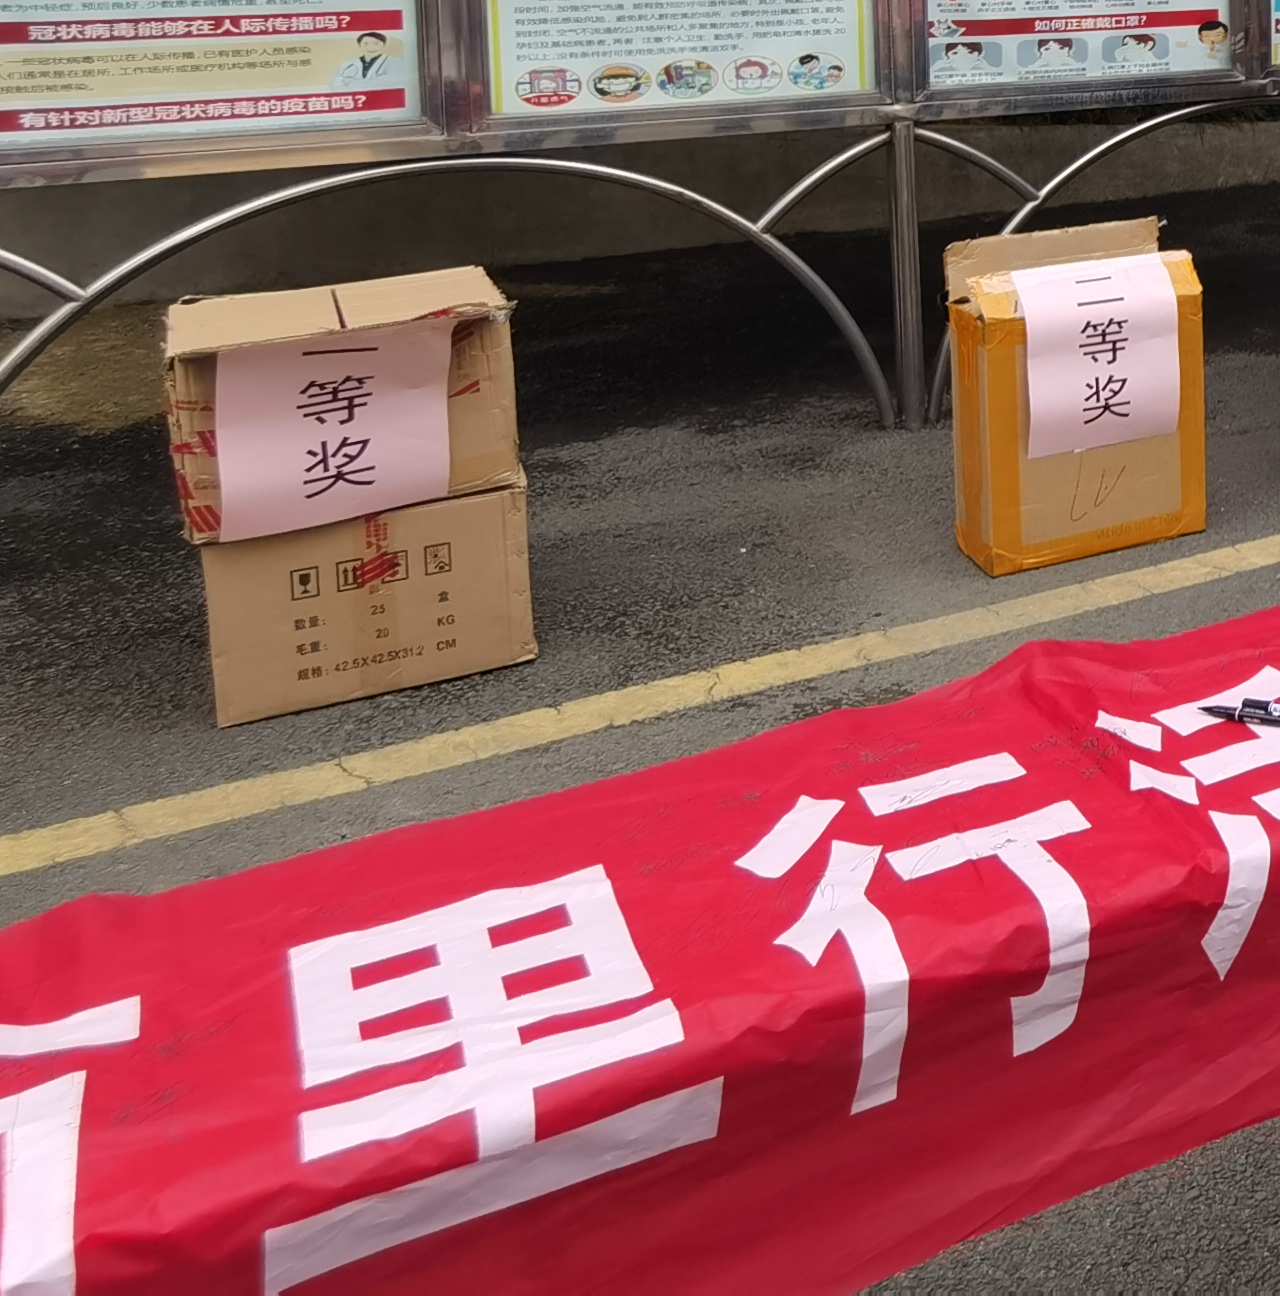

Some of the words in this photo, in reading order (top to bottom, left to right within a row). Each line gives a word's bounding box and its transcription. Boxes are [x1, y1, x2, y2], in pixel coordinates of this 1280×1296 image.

[1075, 276, 1131, 425] 二等奖
[296, 347, 378, 500] 一等奖
[370, 604, 386, 616] 25
[375, 628, 390, 640] 20
[437, 614, 456, 627] KG
[436, 639, 457, 652] CM
